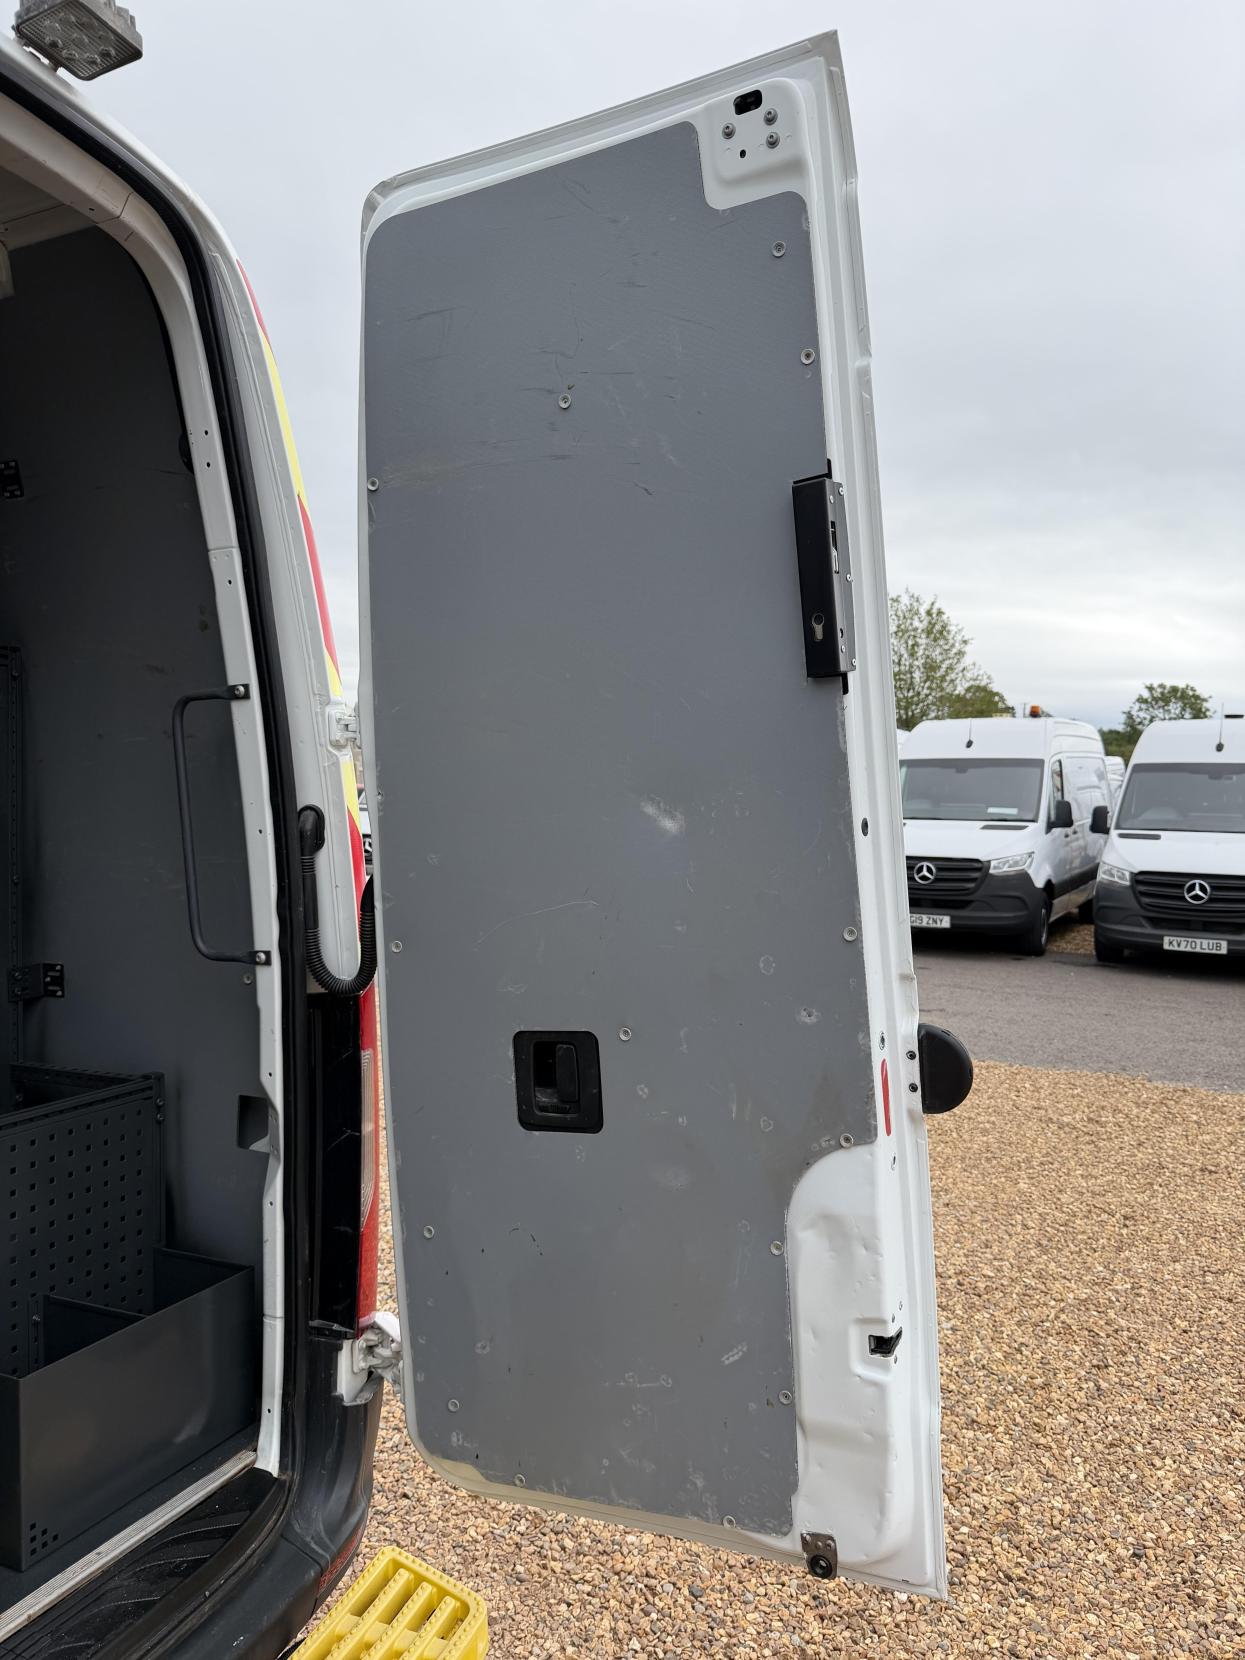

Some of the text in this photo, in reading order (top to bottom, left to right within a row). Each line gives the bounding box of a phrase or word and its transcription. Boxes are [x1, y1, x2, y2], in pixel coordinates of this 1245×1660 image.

[926, 916, 945, 926] ZNY
[1168, 938, 1222, 952] KV70 LUB
